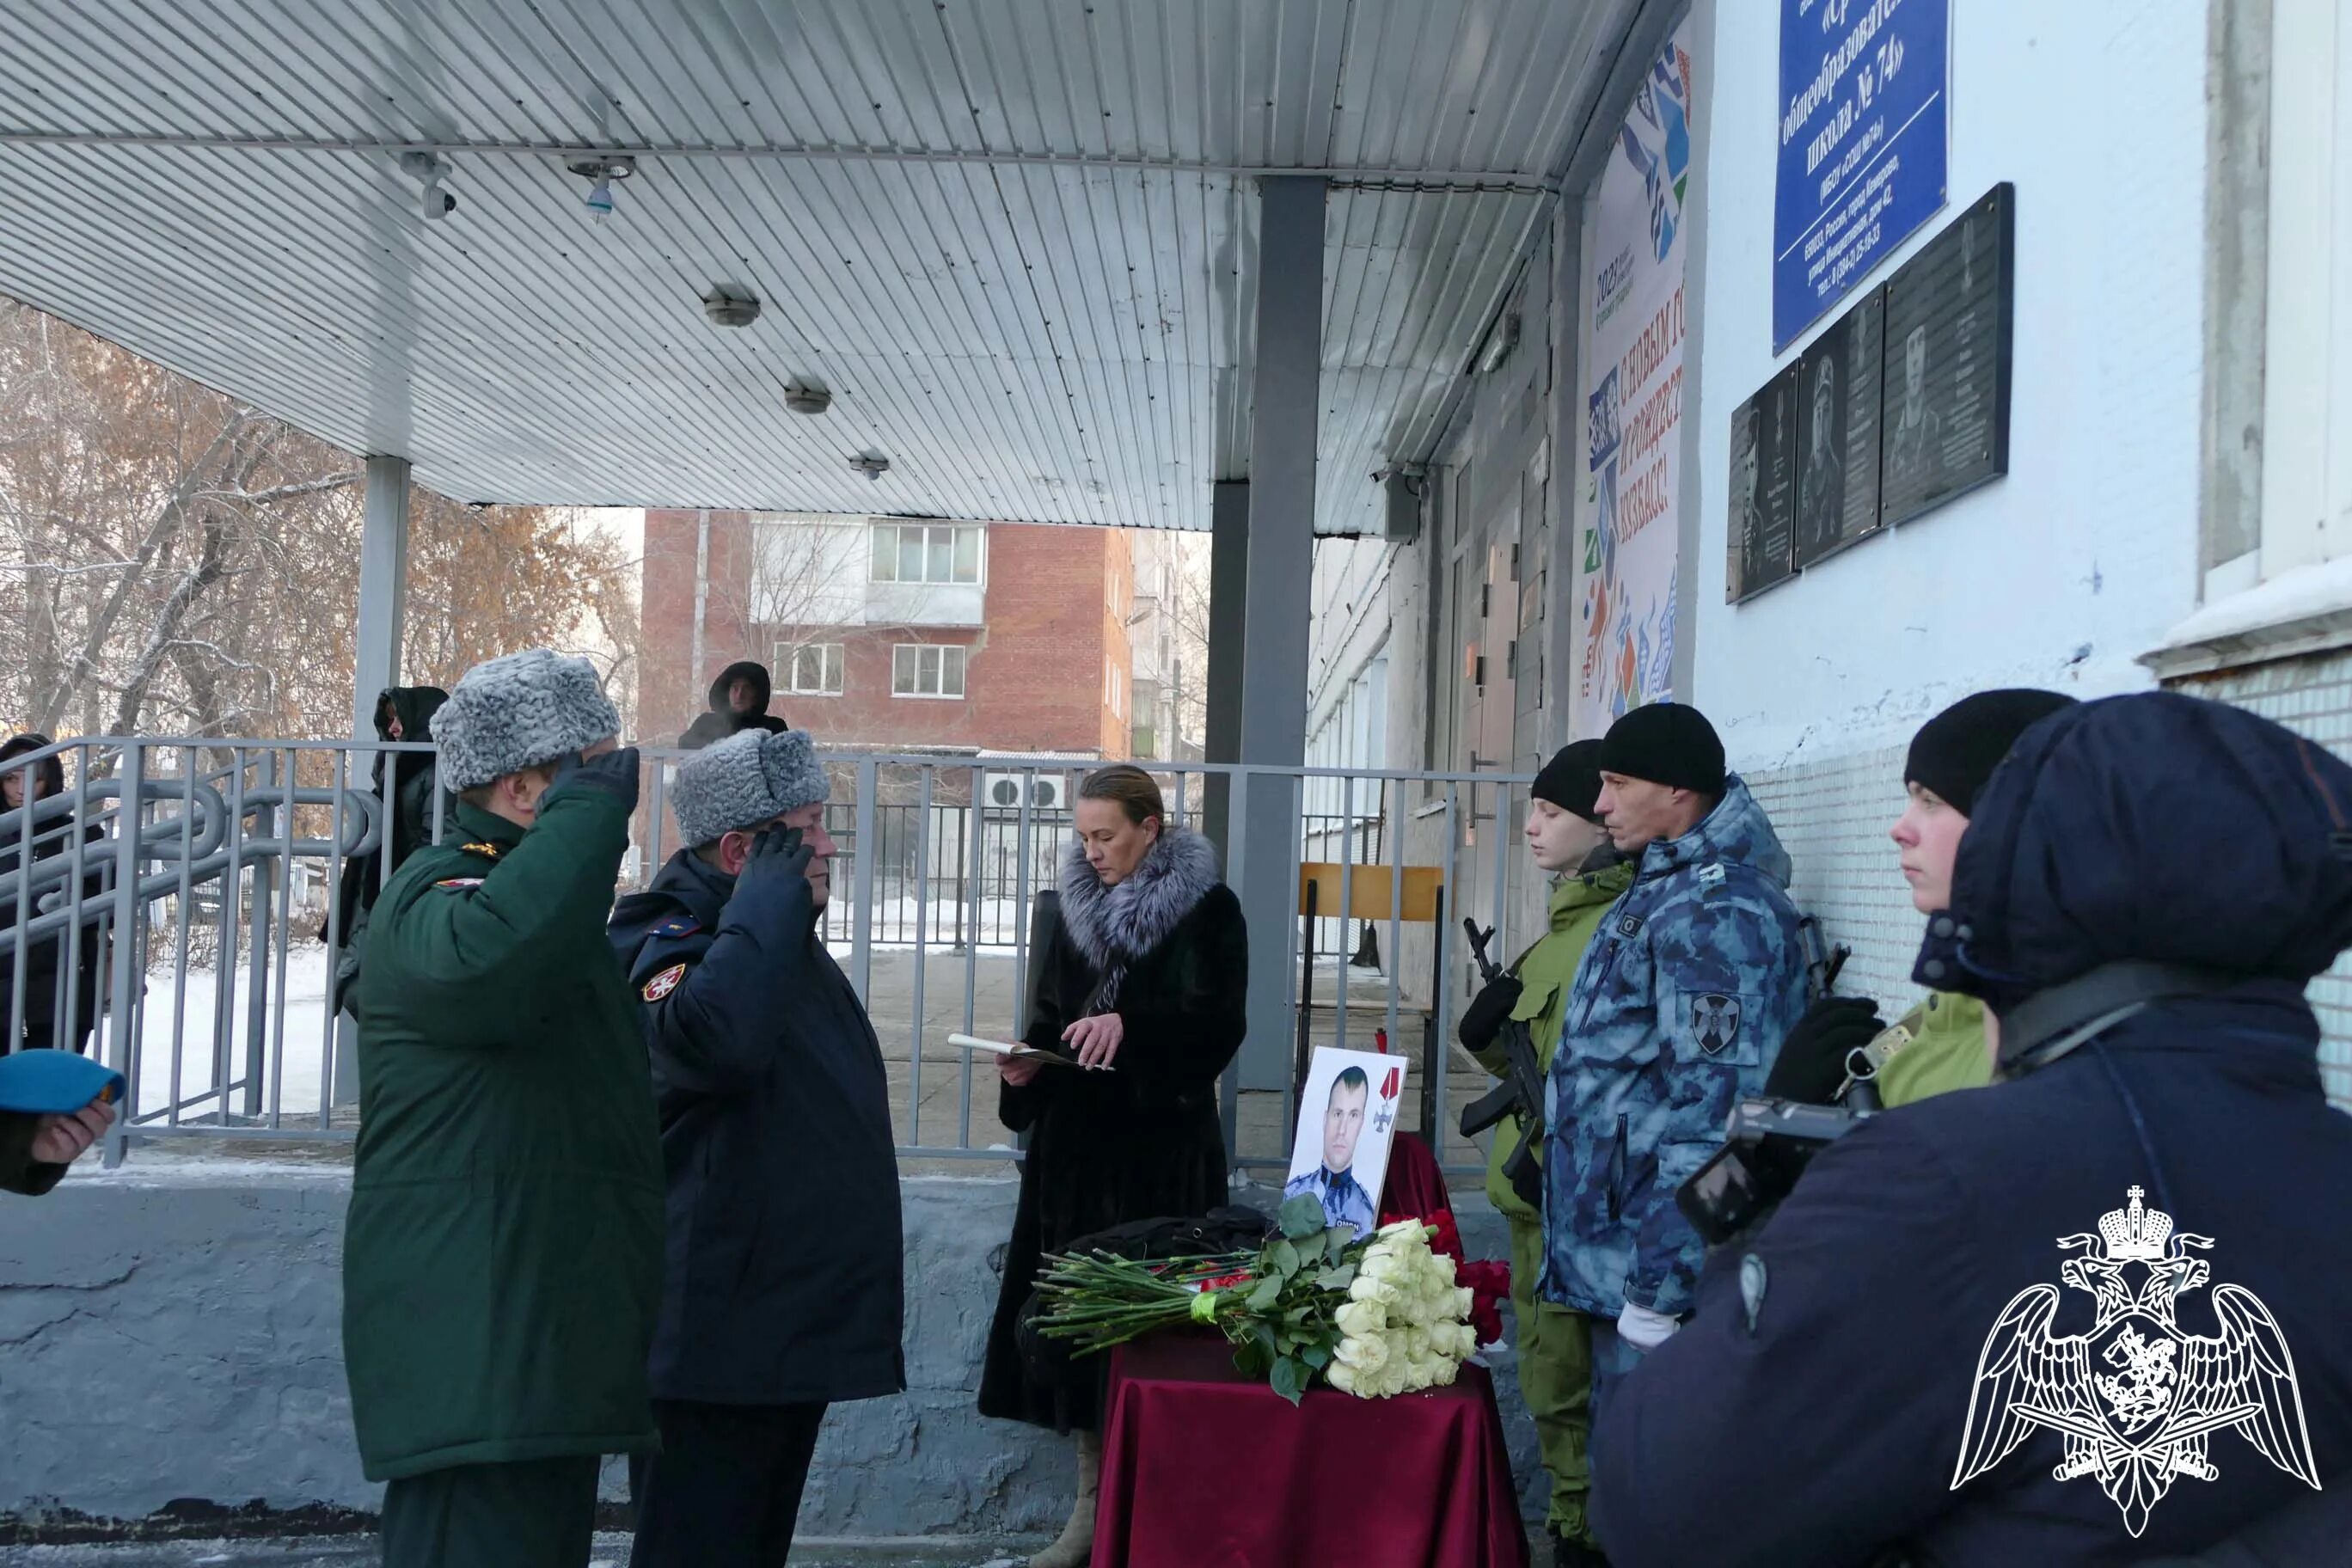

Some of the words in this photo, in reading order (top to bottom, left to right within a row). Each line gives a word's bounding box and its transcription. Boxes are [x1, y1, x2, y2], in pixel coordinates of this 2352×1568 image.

[1808, 99, 1852, 175] школа
[1854, 64, 1873, 120] №
[1877, 34, 1904, 95] 74»
[1820, 162, 1841, 206] (МБОУ
[1826, 210, 1847, 242] Россия,
[1847, 189, 1865, 218] город
[1866, 155, 1899, 199] Кемерово,
[1809, 255, 1825, 287] улица
[1869, 198, 1882, 225] дом
[1620, 355, 1626, 407] С
[1629, 301, 1671, 400] НОВЫМ
[1620, 423, 1632, 477] И
[1620, 453, 1669, 544] КУЗБАСС!
